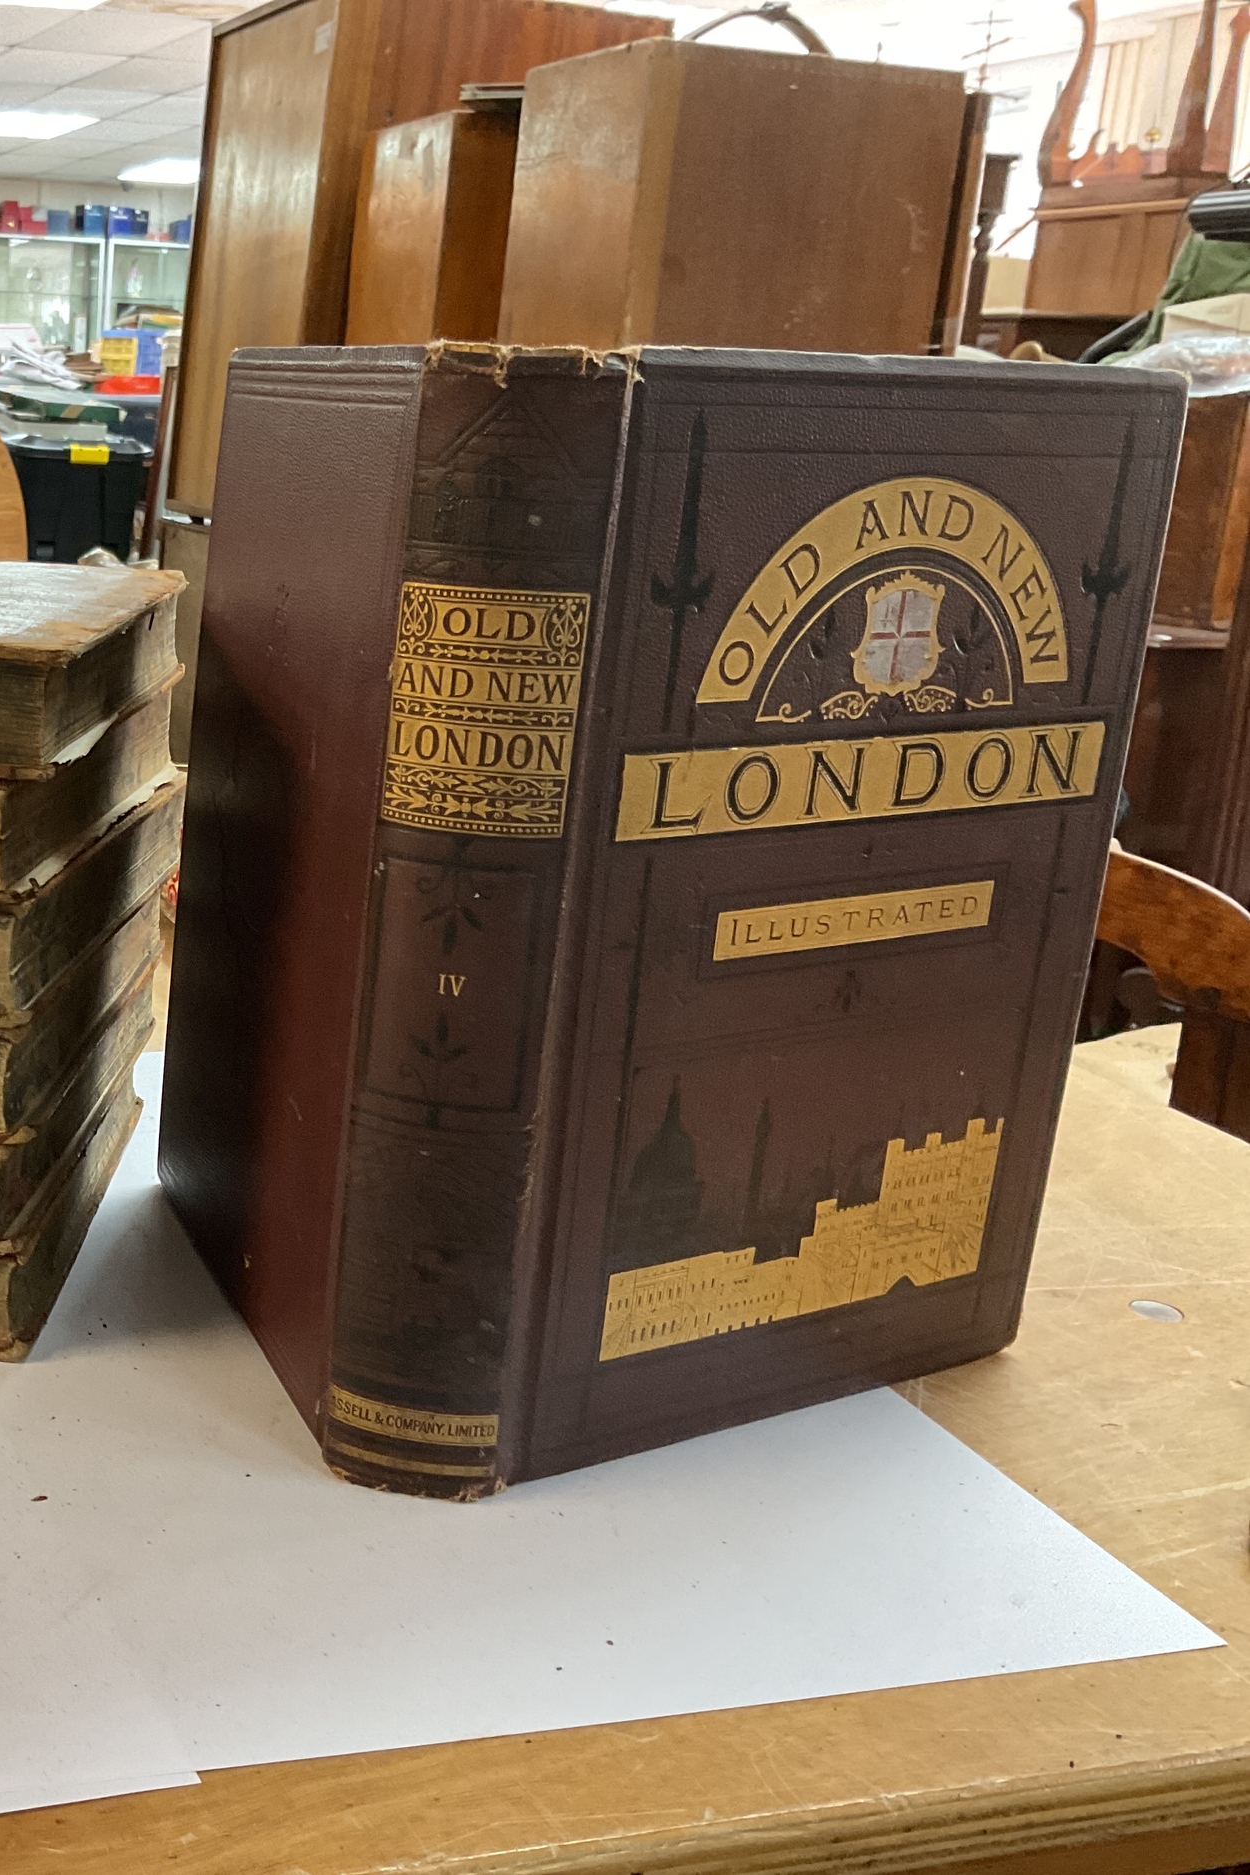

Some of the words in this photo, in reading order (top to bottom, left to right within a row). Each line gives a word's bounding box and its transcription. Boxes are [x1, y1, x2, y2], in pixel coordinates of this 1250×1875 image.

[718, 543, 821, 686] OLD
[855, 489, 975, 551] AND
[982, 523, 1060, 665] NEW
[442, 607, 536, 643] OLD
[397, 662, 474, 698] AND
[486, 671, 577, 705] NEW
[392, 720, 566, 771] LONDON
[640, 725, 1088, 836] LONDON
[729, 896, 978, 946] ILLUSTRATED
[438, 973, 467, 997] IV
[447, 1423, 496, 1438] LIMITED
